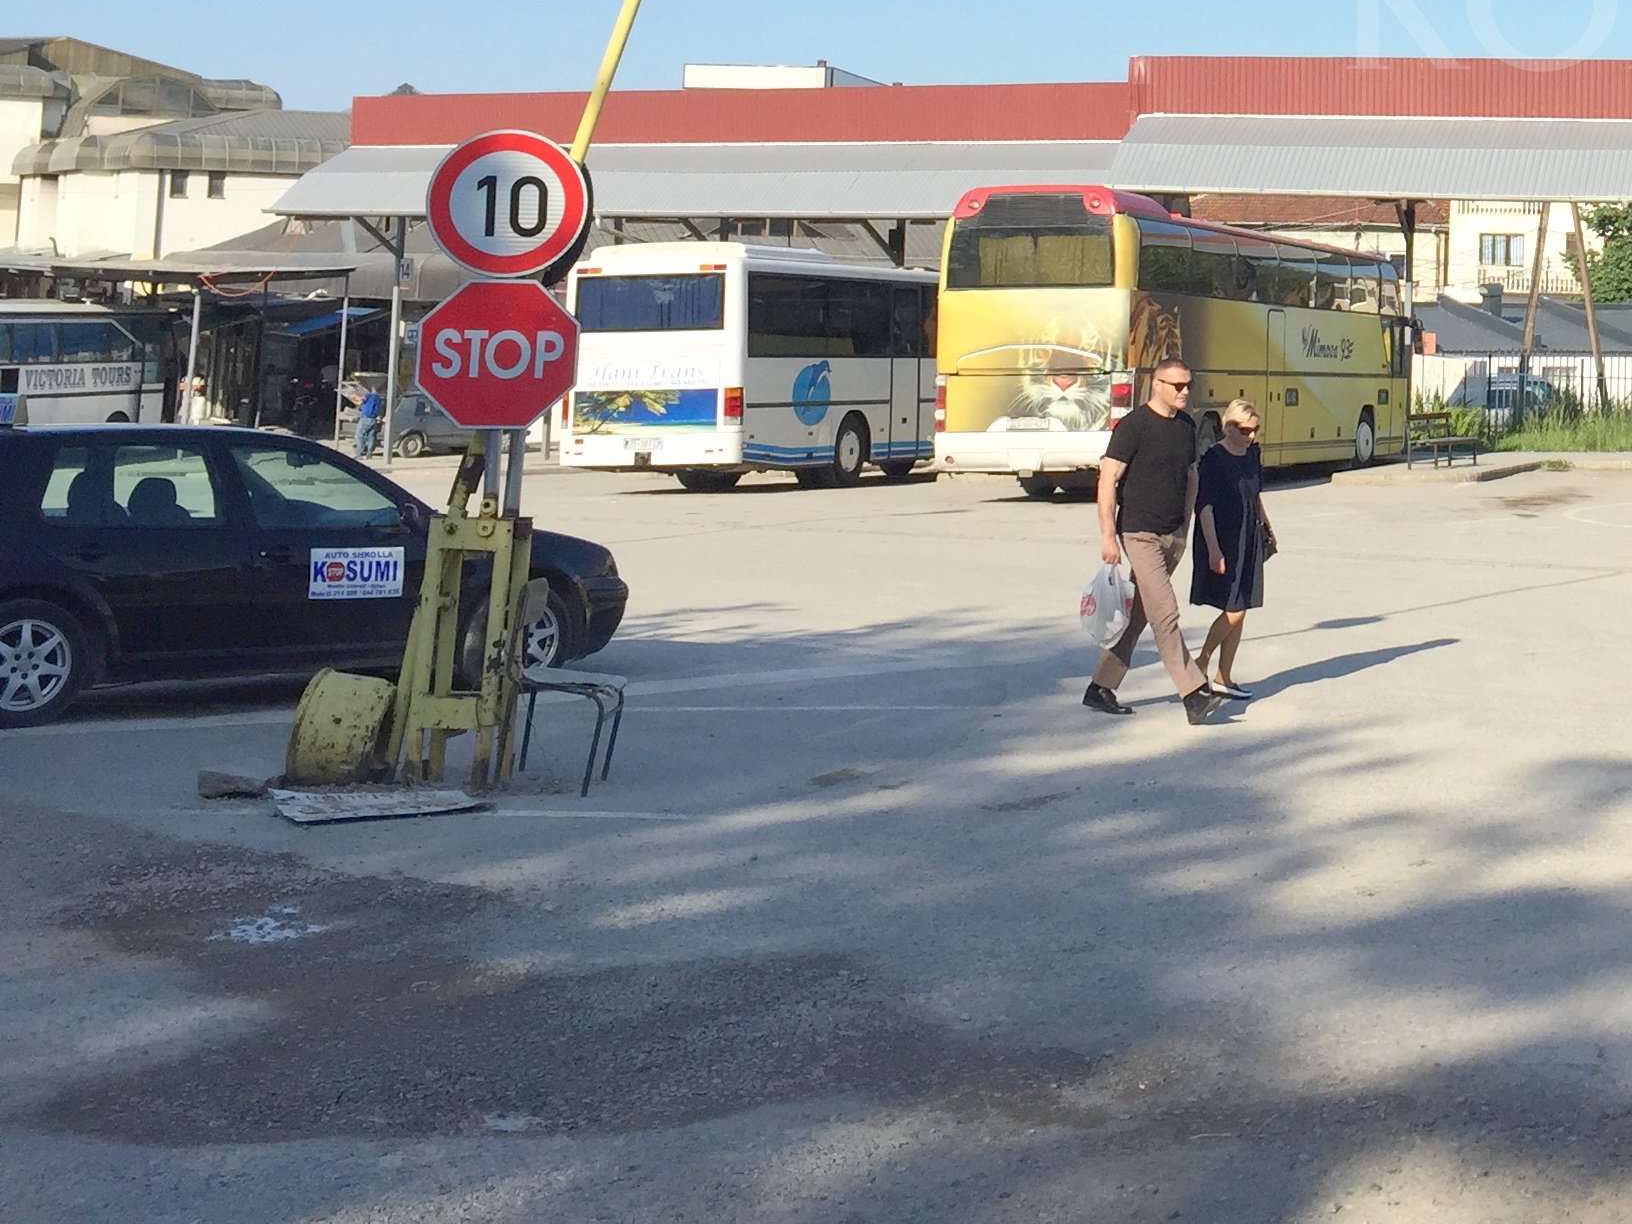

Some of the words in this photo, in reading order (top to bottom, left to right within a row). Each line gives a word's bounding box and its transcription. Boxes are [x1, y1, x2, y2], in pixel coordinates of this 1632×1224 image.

[476, 175, 549, 237] 10
[25, 368, 86, 388] VICTORIA
[92, 367, 131, 385] TOURS
[431, 329, 565, 379] STOP
